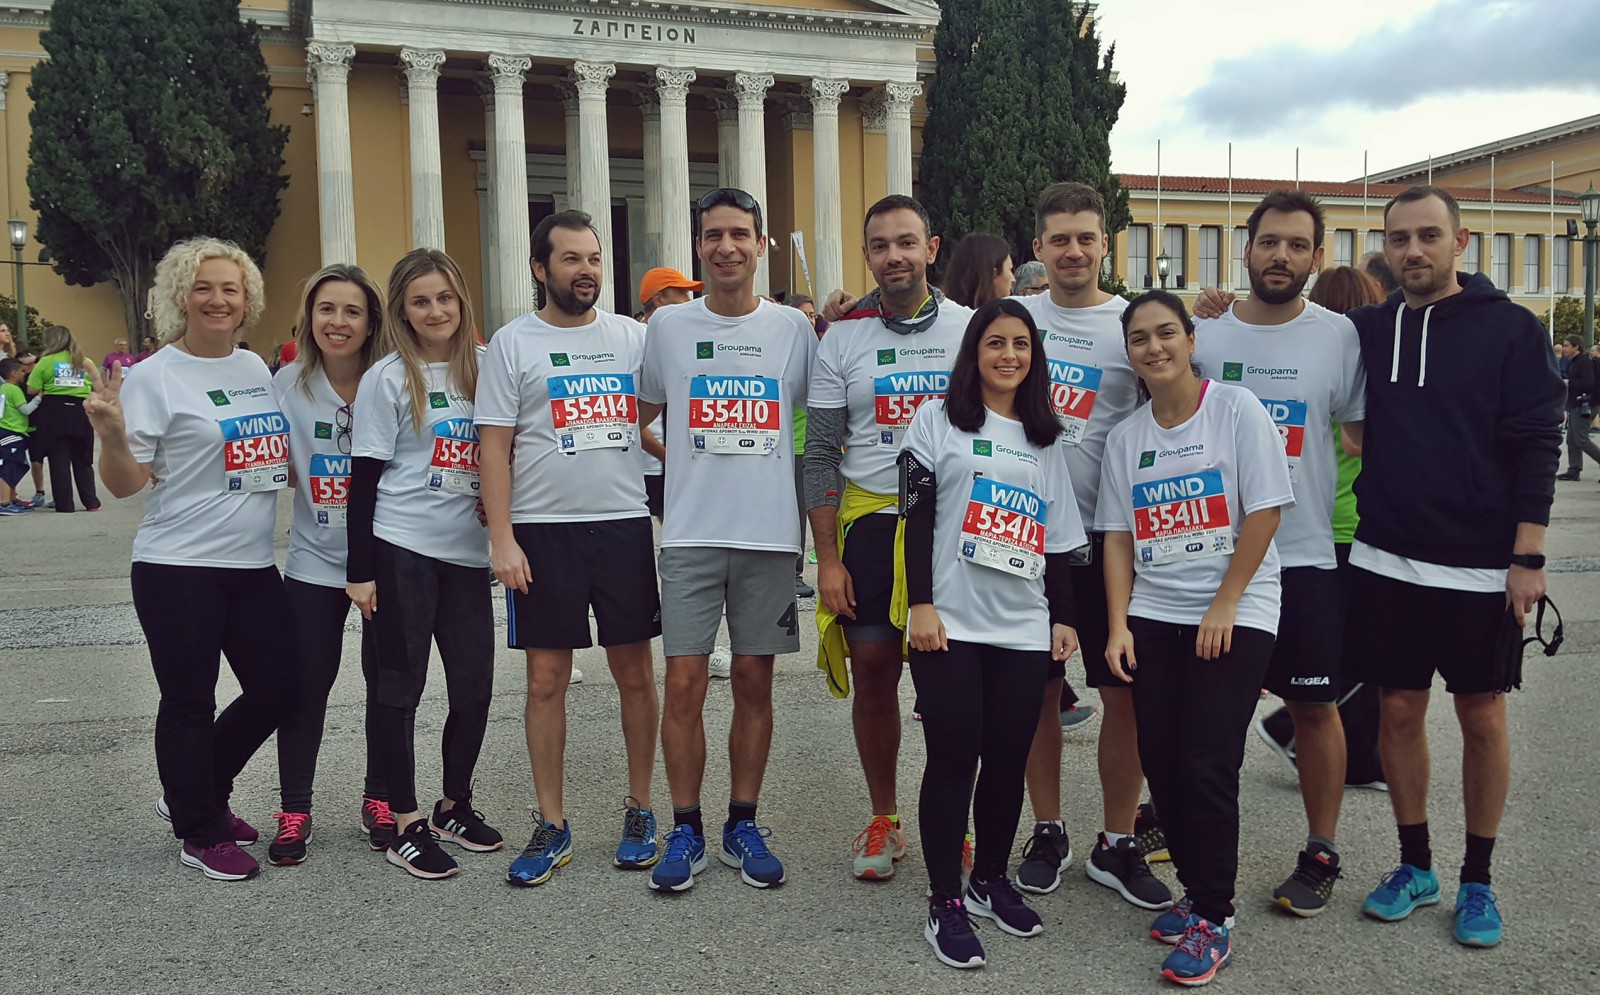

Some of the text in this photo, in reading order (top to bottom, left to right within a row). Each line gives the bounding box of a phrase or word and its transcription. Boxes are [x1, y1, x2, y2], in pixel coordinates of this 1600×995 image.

[717, 343, 762, 353] Groupama
[1049, 333, 1094, 347] Groupama
[571, 352, 615, 361] Groupama
[899, 347, 945, 356] Groupama
[1246, 365, 1298, 376] Groupama
[228, 386, 266, 397] Groupama
[563, 376, 622, 395] WIND
[705, 379, 766, 397] WIND
[890, 374, 950, 392] WIND
[564, 395, 628, 421] 55414
[701, 400, 769, 424] 55410
[235, 415, 284, 436] WIND
[995, 444, 1039, 462] Groupama
[1159, 444, 1204, 458] Groupama
[324, 458, 351, 474] WI
[1142, 477, 1205, 503] WIND
[991, 484, 1039, 516] WIND
[1147, 498, 1210, 532] 55411
[976, 504, 1039, 546] 55412
[776, 601, 797, 636] 4
[1290, 676, 1330, 686] LEGEA
